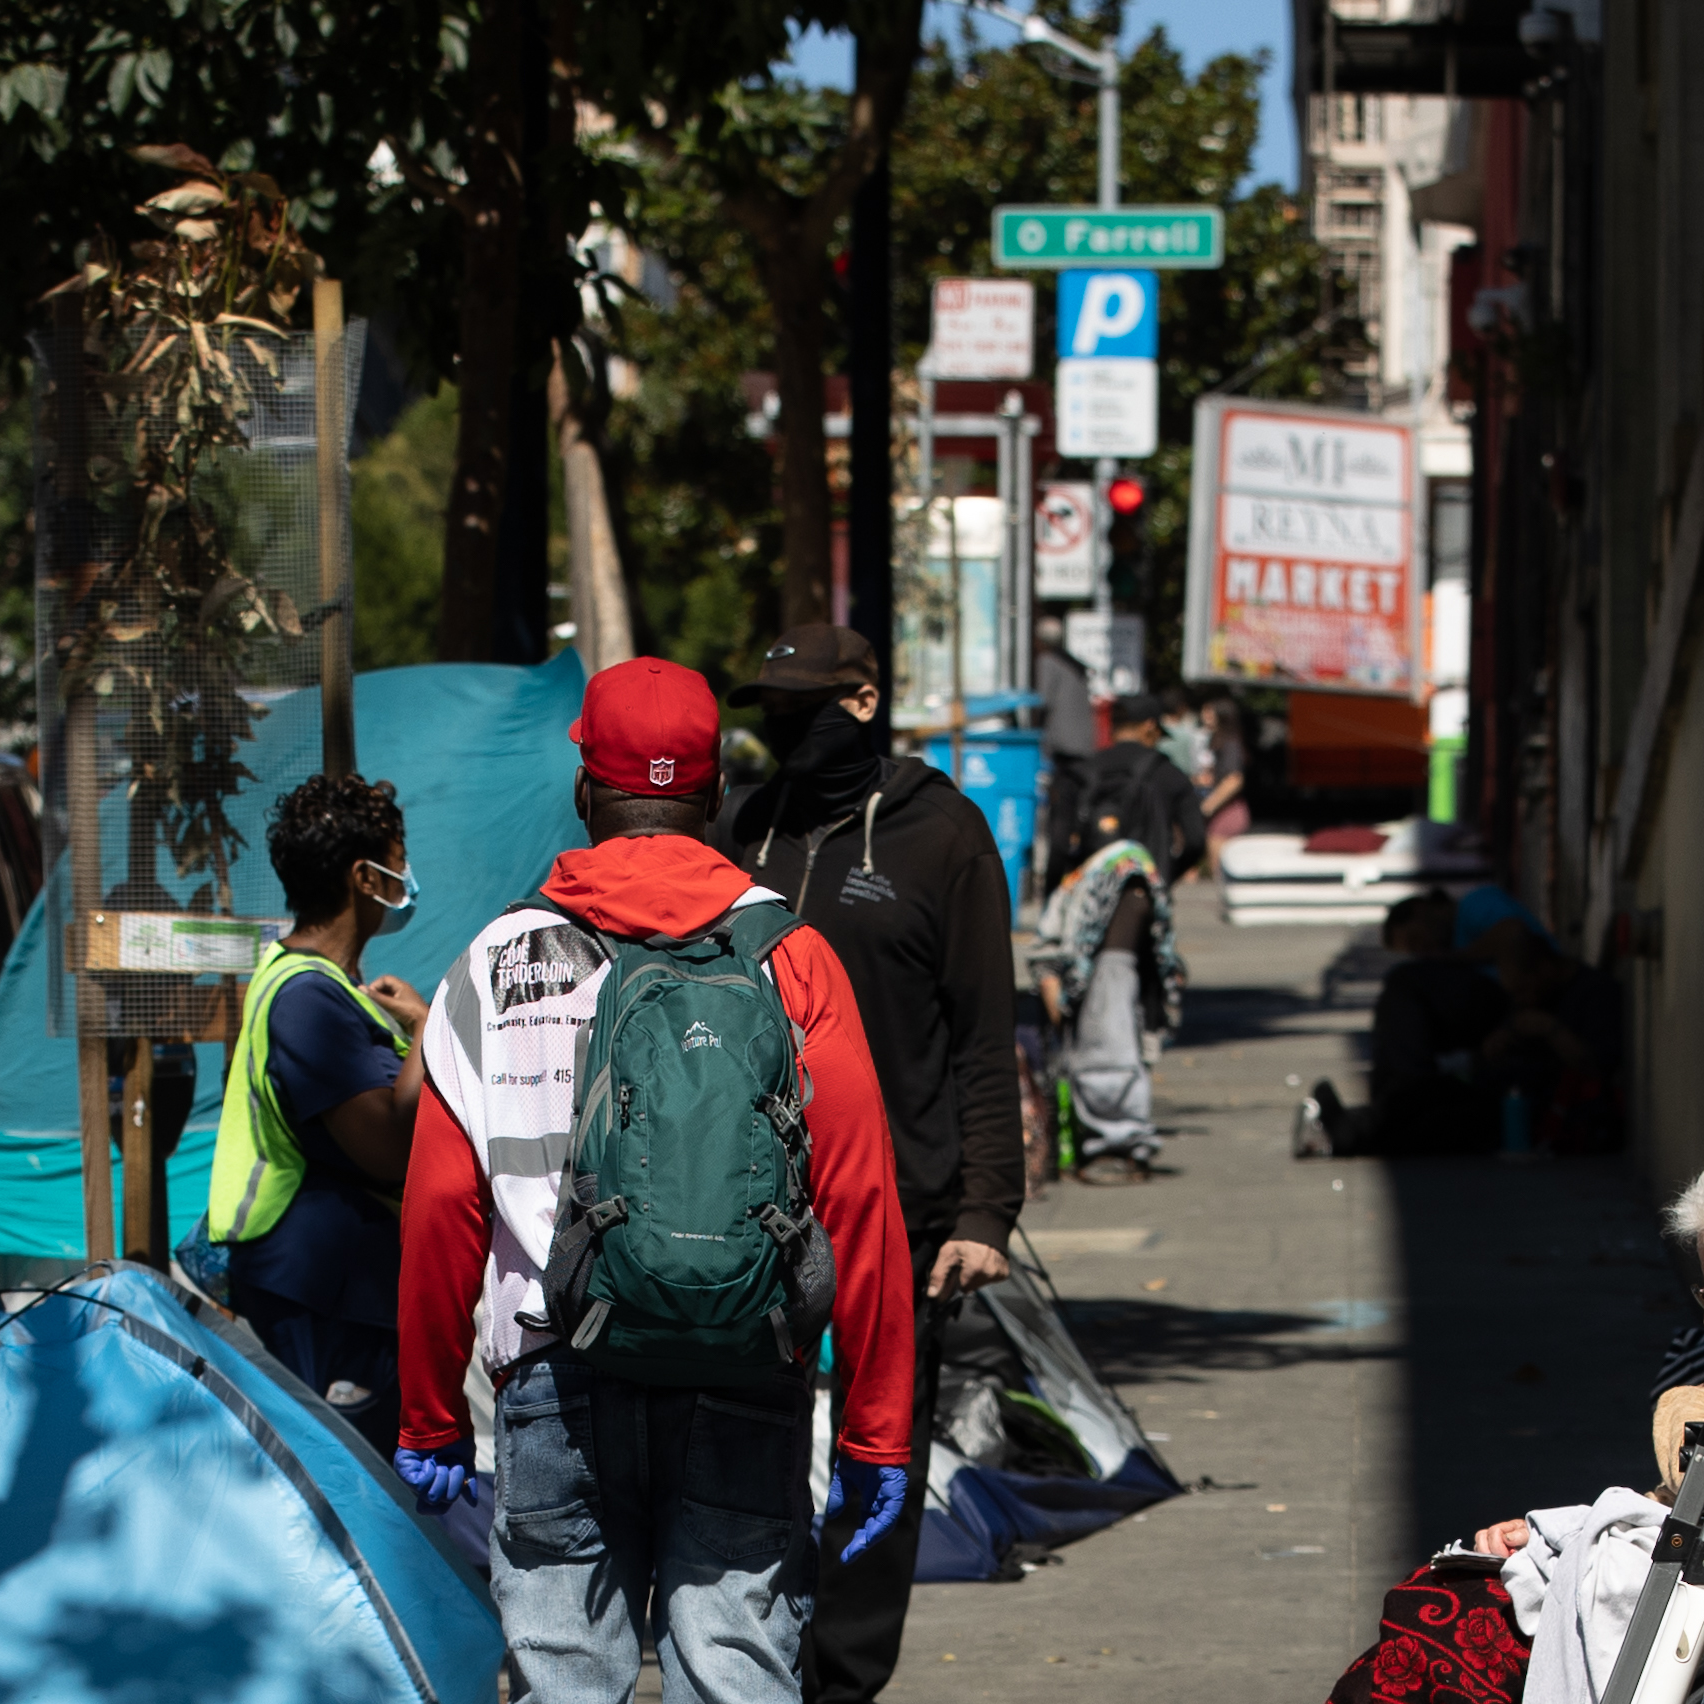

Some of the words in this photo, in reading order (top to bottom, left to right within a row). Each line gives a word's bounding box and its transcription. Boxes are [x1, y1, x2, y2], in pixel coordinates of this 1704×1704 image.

[1017, 219, 1048, 254] O
[1063, 218, 1200, 254] Farrell
[1225, 556, 1401, 616] MARKET
[499, 942, 530, 968] CODE
[496, 961, 574, 989] TENDERLOIN
[491, 1073, 507, 1085] Call
